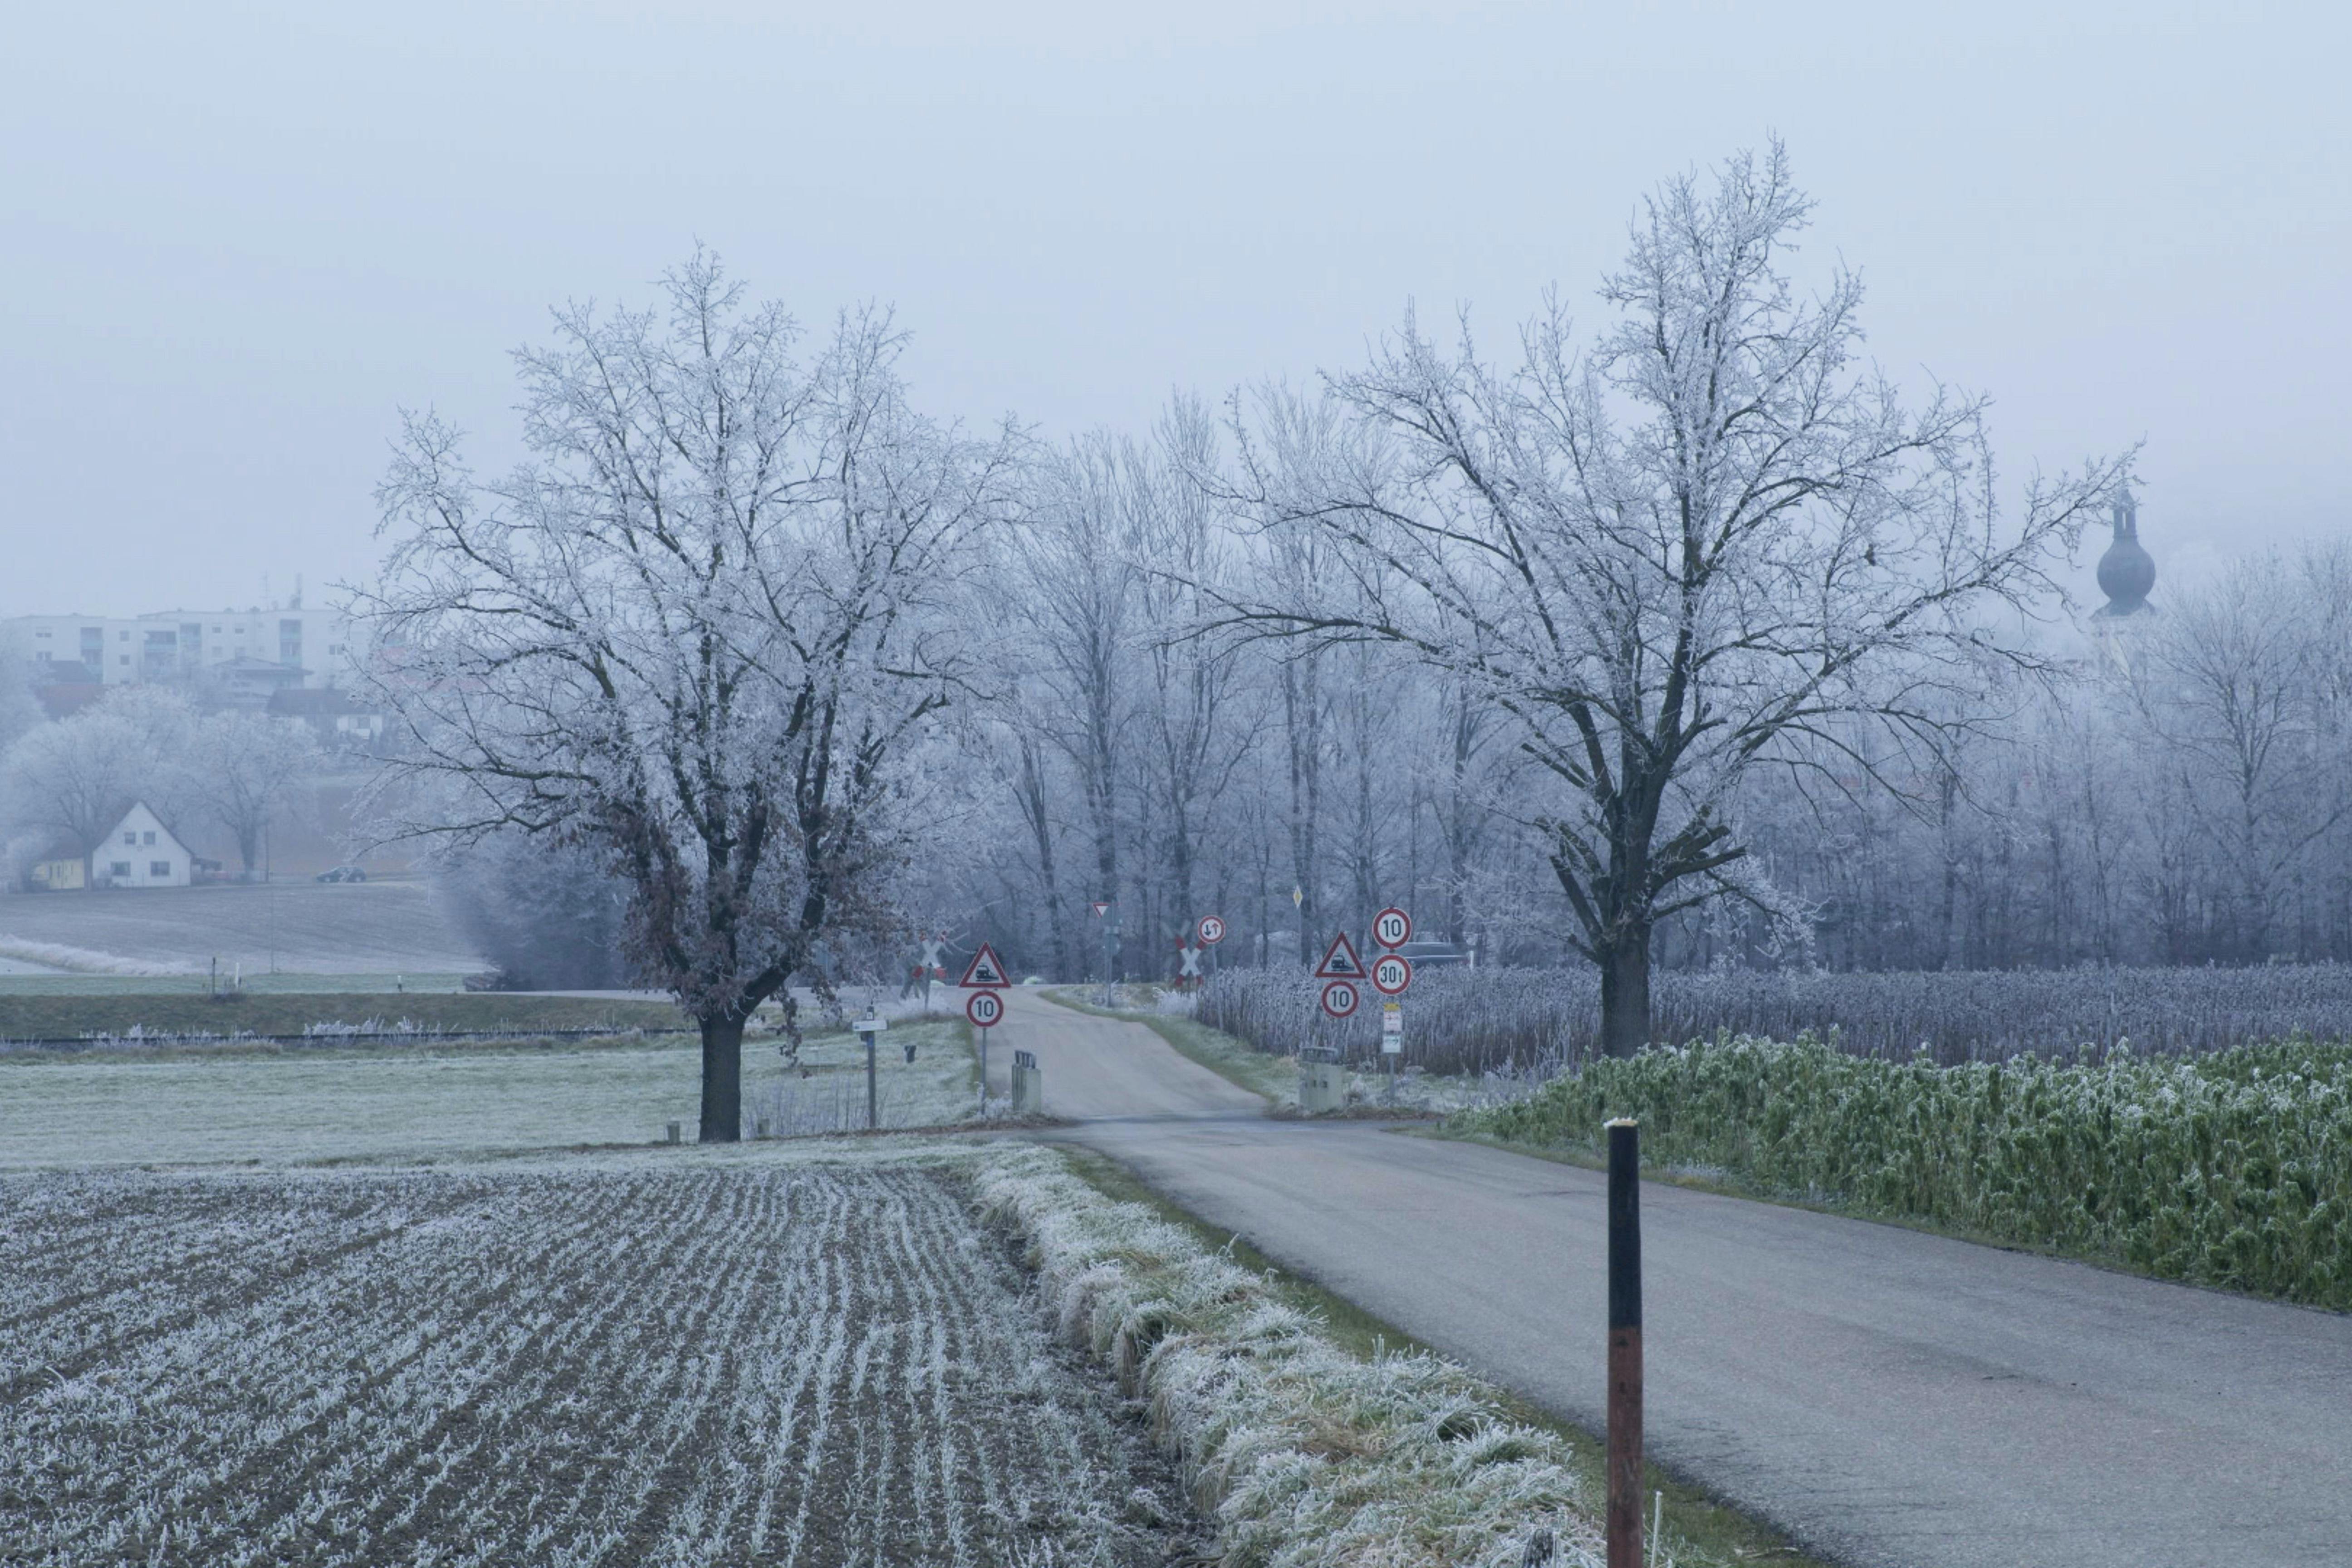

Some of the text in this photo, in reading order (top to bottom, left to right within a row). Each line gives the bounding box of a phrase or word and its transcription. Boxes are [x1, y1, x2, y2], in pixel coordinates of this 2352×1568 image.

[1383, 919, 1401, 937] 10
[1331, 991, 1349, 1007] 10
[976, 1000, 993, 1017] 10
